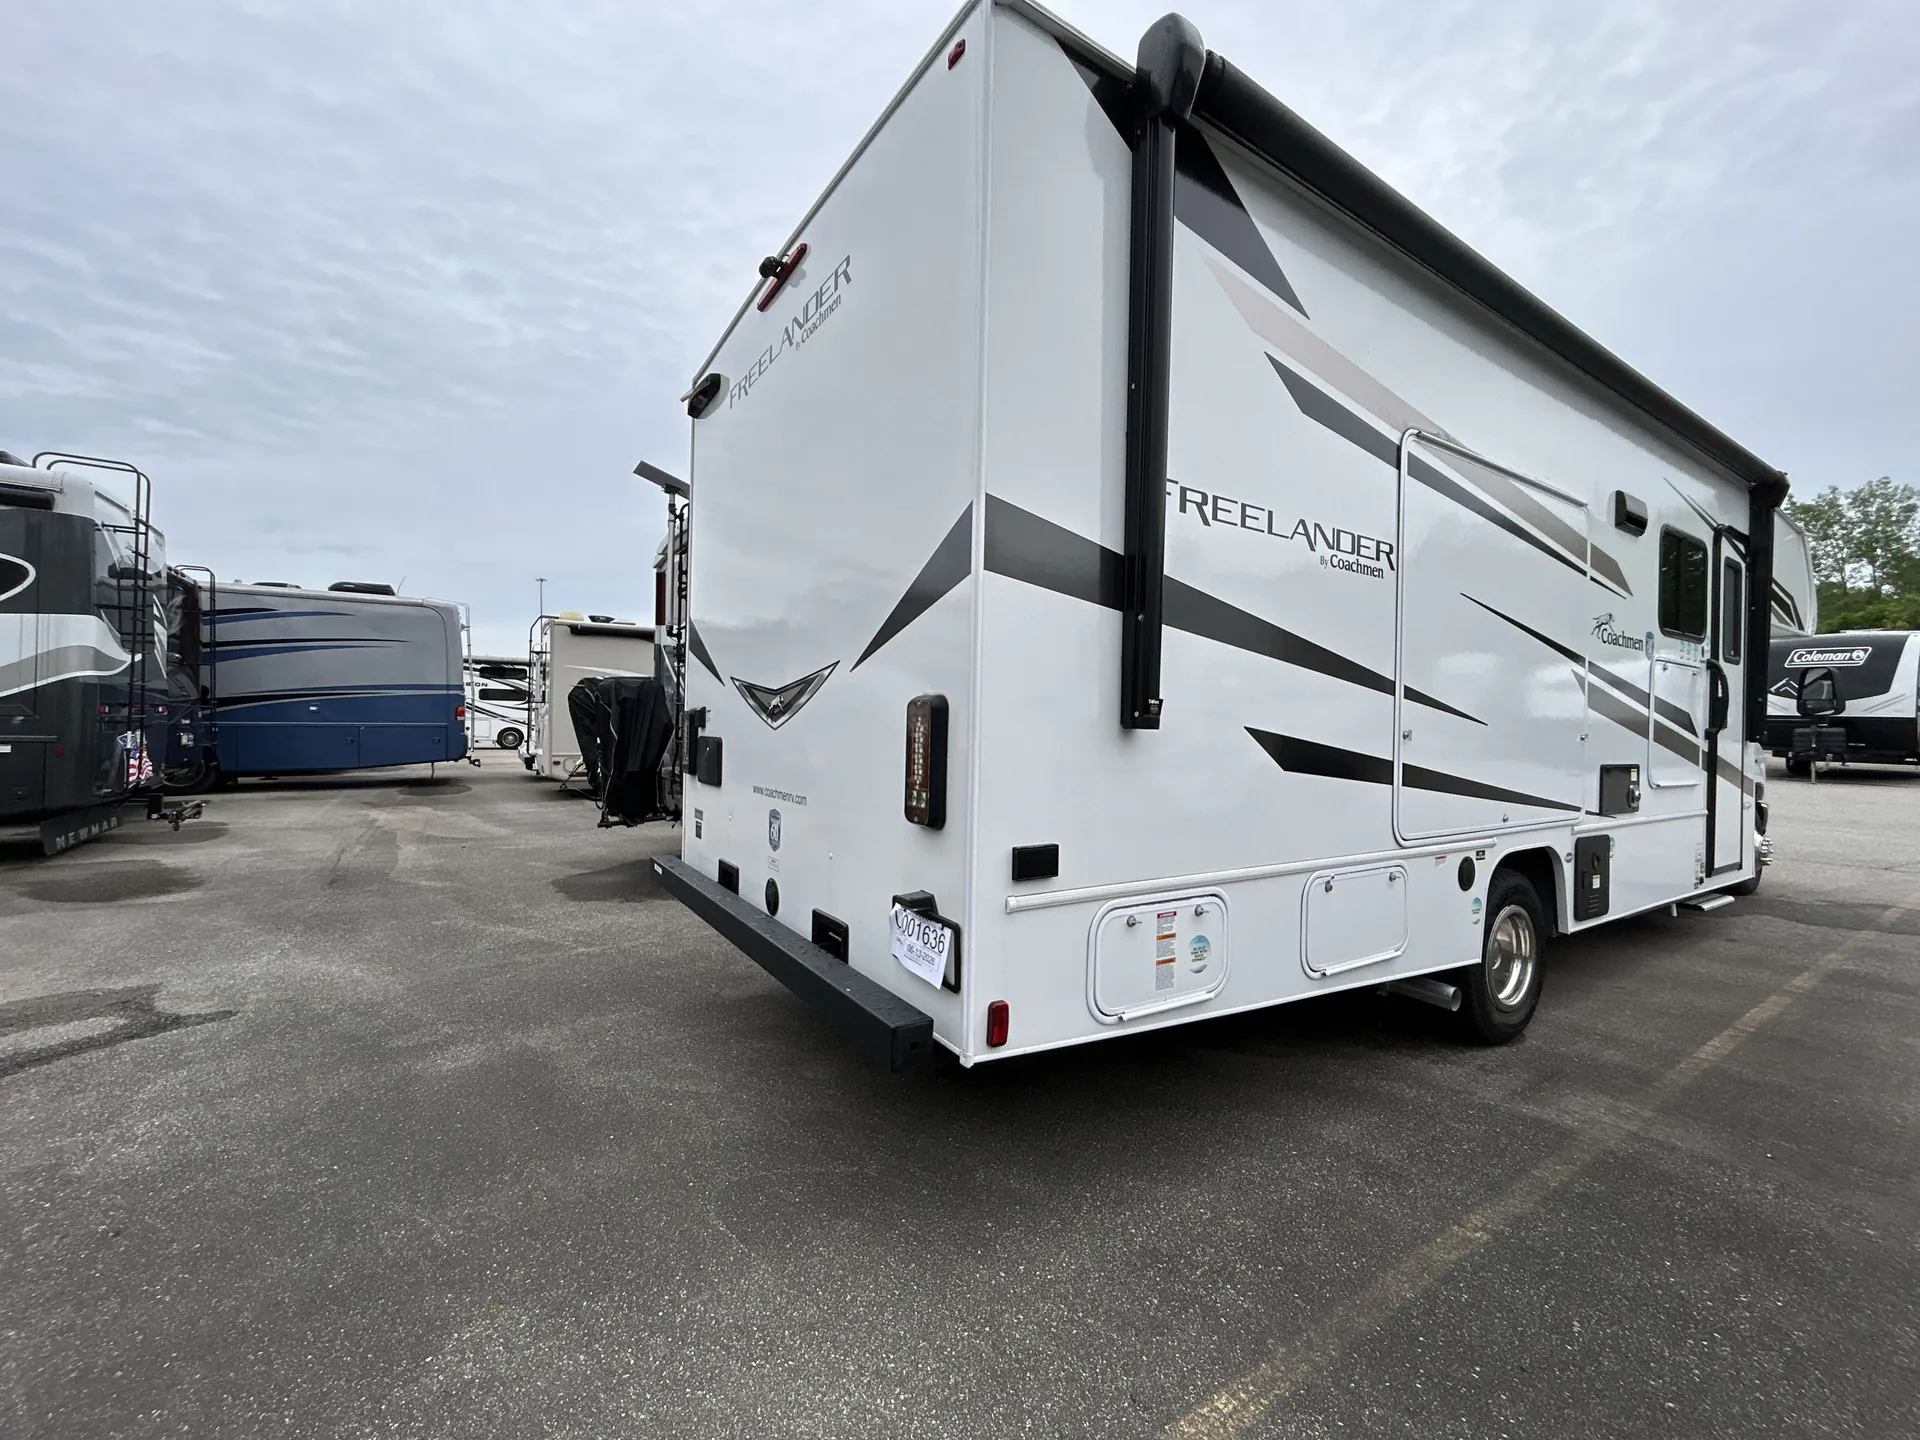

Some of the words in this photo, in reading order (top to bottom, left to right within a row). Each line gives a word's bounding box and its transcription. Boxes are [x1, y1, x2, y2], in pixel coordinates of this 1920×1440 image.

[801, 294, 841, 343] Coachmen
[730, 255, 852, 409] FREELANDER
[1320, 555, 1329, 568] By
[1330, 554, 1384, 579] Coachmen
[1601, 628, 1644, 651] Coachmen
[1793, 650, 1851, 662] Coleman
[753, 785, 807, 806] www.coachmenrv.com
[56, 816, 118, 849] NEWMAR
